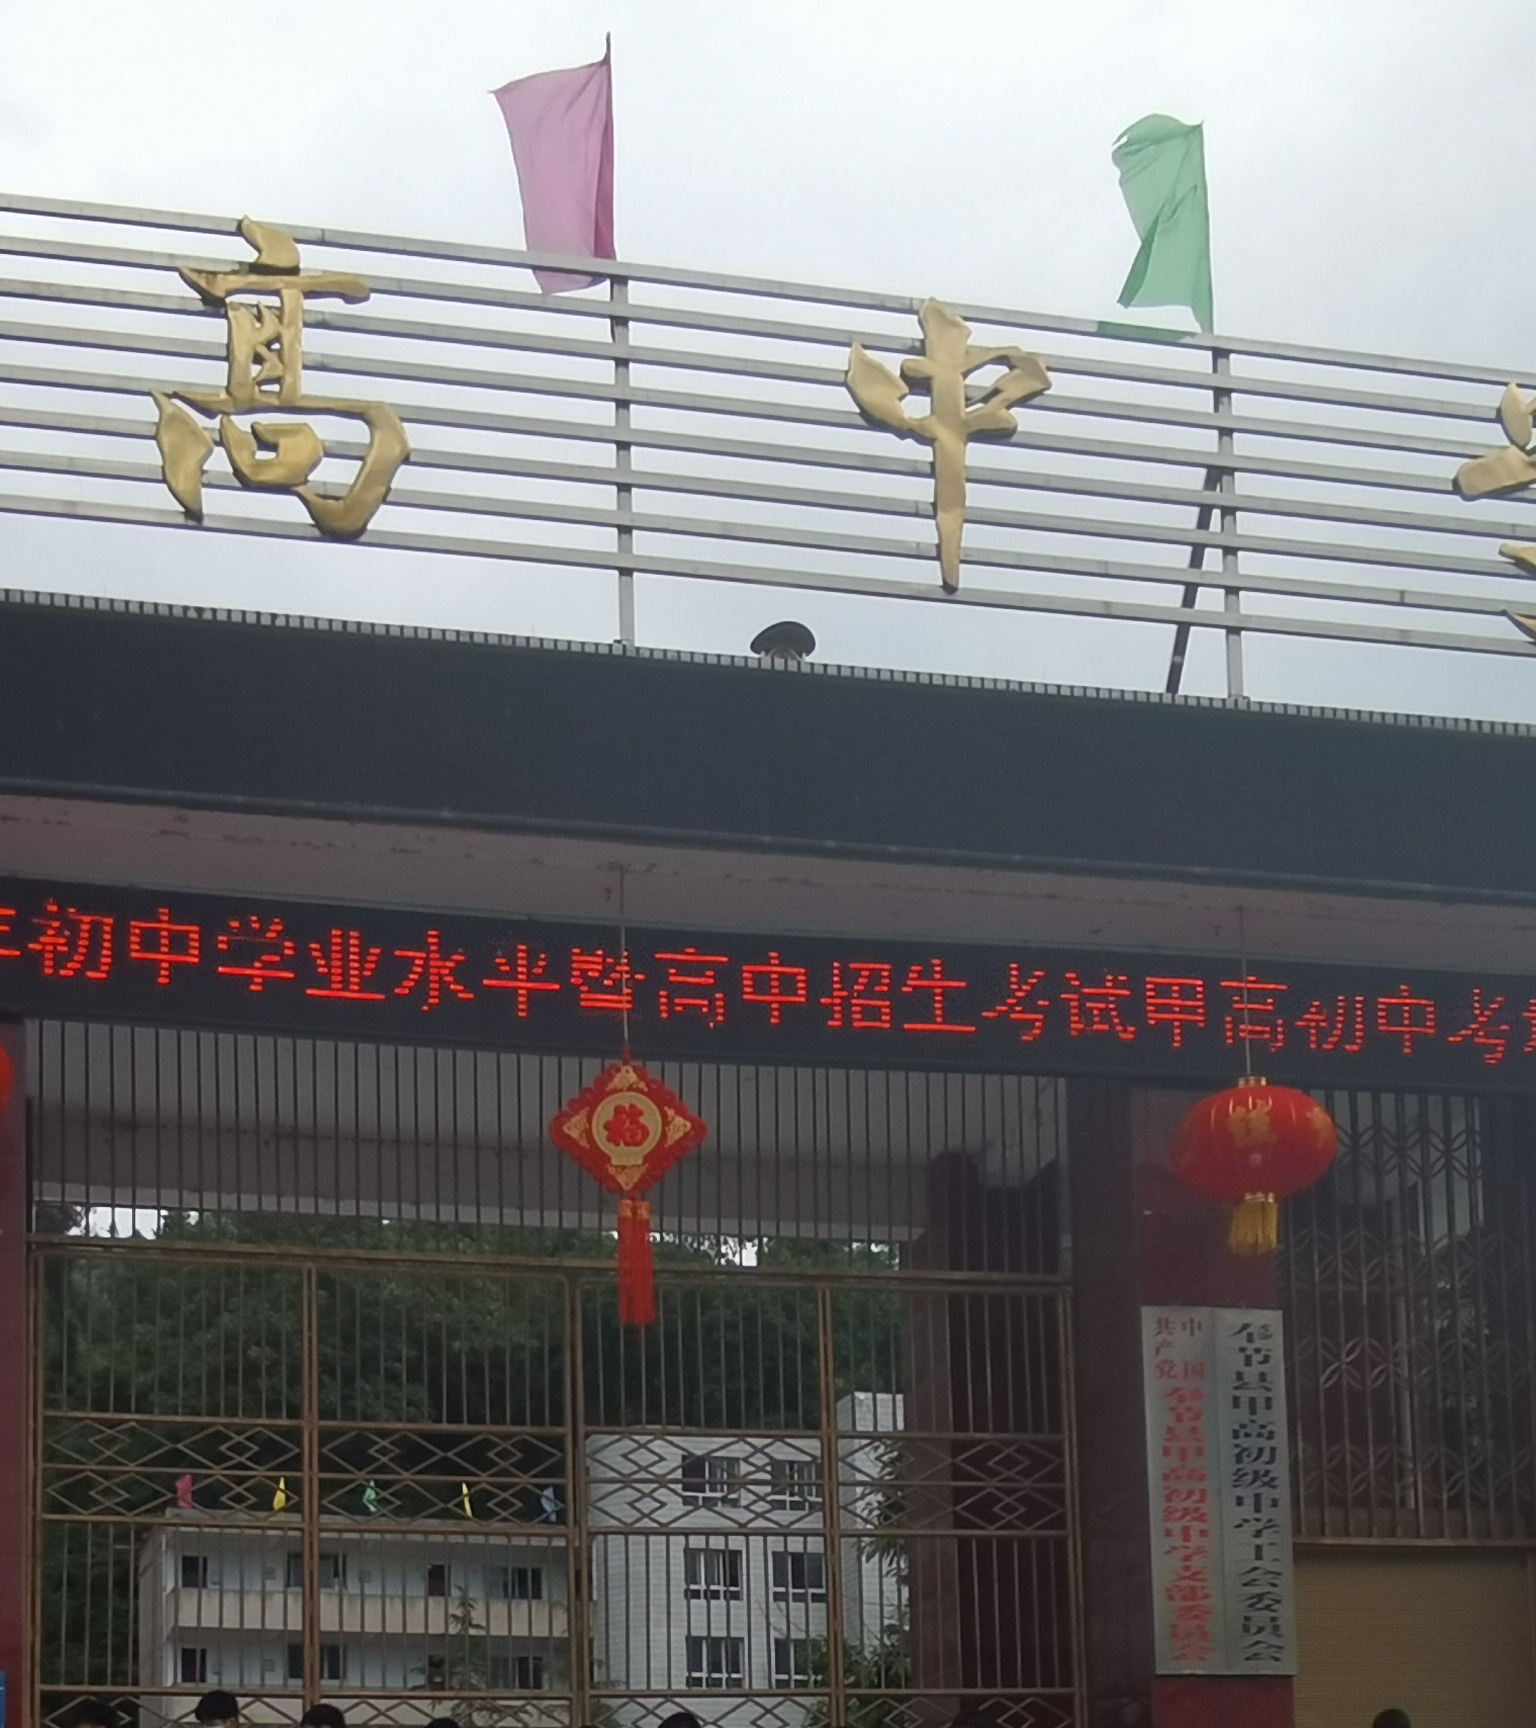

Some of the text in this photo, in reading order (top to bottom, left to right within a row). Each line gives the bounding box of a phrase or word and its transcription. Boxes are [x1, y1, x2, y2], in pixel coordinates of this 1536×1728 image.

[604, 1102, 651, 1148] 福
[1231, 1321, 1284, 1662] 奉节县甲高初级中学工会委员会
